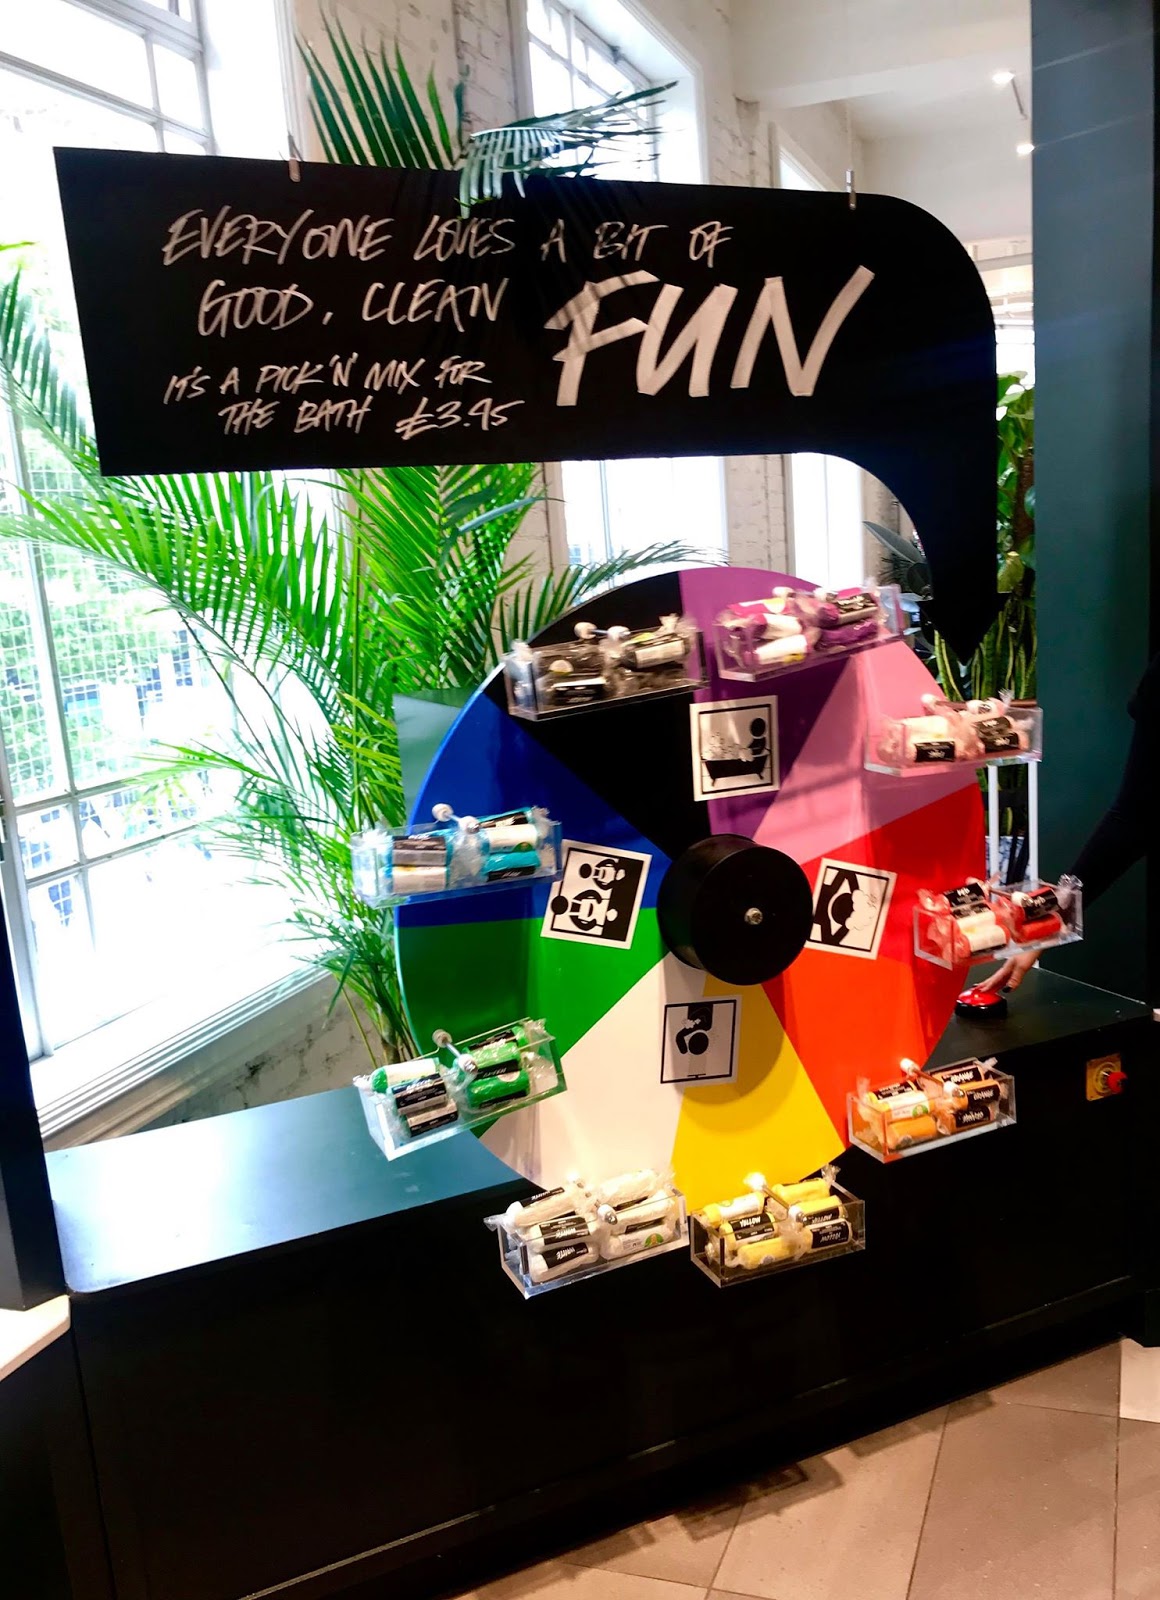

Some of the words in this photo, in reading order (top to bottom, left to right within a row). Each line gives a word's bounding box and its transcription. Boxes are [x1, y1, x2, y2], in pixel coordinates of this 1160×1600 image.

[162, 205, 394, 266] EVERYONE
[413, 214, 516, 262] LOVES
[540, 218, 567, 263] A
[593, 220, 669, 261] BIT
[689, 221, 734, 268] OF
[361, 277, 510, 333] CLEAN
[543, 265, 875, 406] FUN
[163, 366, 211, 405] IT'S
[219, 366, 241, 396] A
[255, 360, 324, 395] PICK
[364, 358, 426, 395] MIX
[434, 355, 493, 389] FOR
[217, 398, 280, 435] THE
[293, 394, 374, 434] BATH
[394, 396, 525, 440] £3.95
